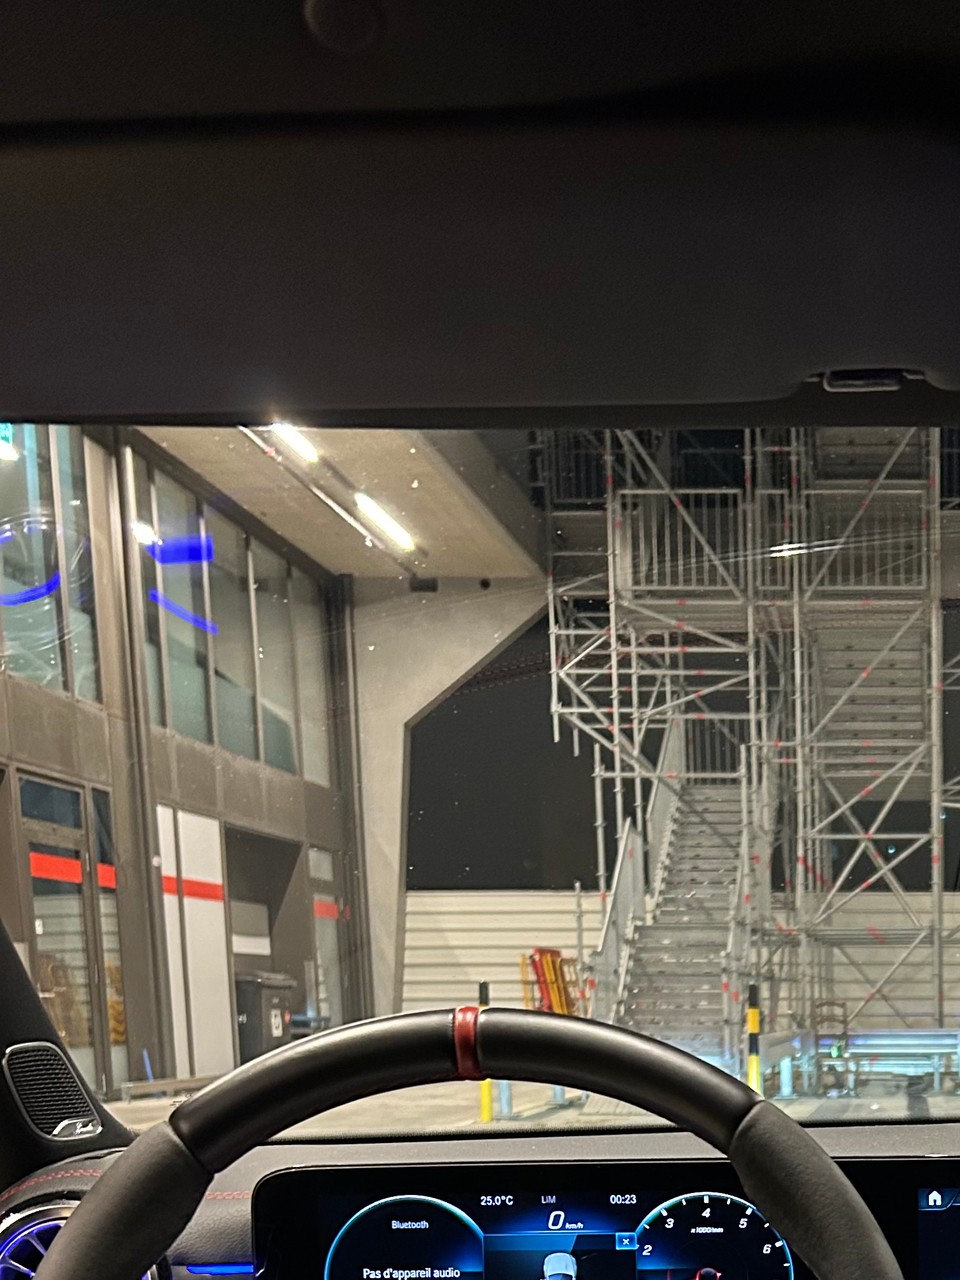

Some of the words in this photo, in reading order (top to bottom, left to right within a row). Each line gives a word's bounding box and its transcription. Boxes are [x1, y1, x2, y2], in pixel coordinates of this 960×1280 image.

[480, 1195, 514, 1206] 25.0°C
[541, 1195, 556, 1205] LIM
[609, 1194, 637, 1205] 00:23
[701, 1207, 711, 1218] 4
[391, 1220, 429, 1229] Bluetooth
[547, 1210, 565, 1230] 0
[565, 1222, 584, 1230] km/h
[664, 1218, 675, 1229] 3
[738, 1218, 748, 1229] 5
[642, 1244, 653, 1256] 2
[762, 1243, 772, 1255] 6
[363, 1268, 382, 1279] Pas
[382, 1267, 432, 1280] d'appareil
[433, 1267, 461, 1278] audio
